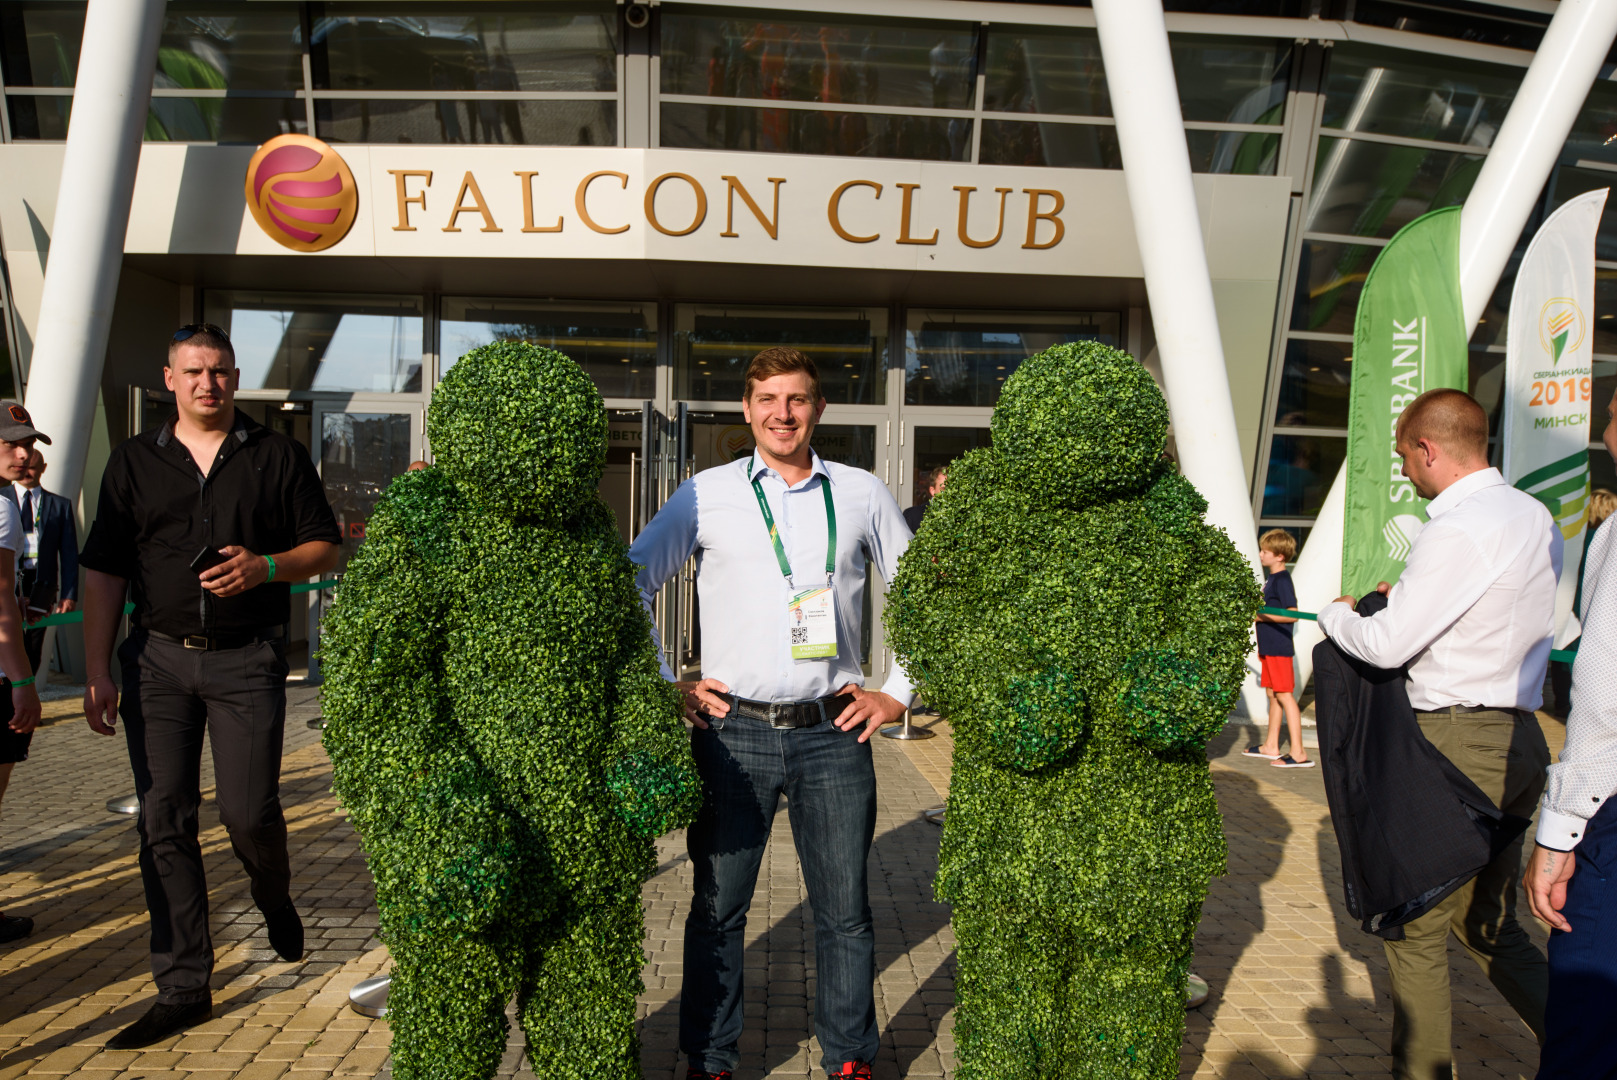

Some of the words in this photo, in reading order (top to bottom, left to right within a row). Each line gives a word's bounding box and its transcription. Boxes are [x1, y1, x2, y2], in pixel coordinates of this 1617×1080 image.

[387, 170, 786, 240] FALCON
[827, 180, 1065, 249] CLUB
[1389, 317, 1418, 503] SBBANK
[1529, 377, 1590, 406] 2019
[1534, 412, 1587, 429] МИНСК
